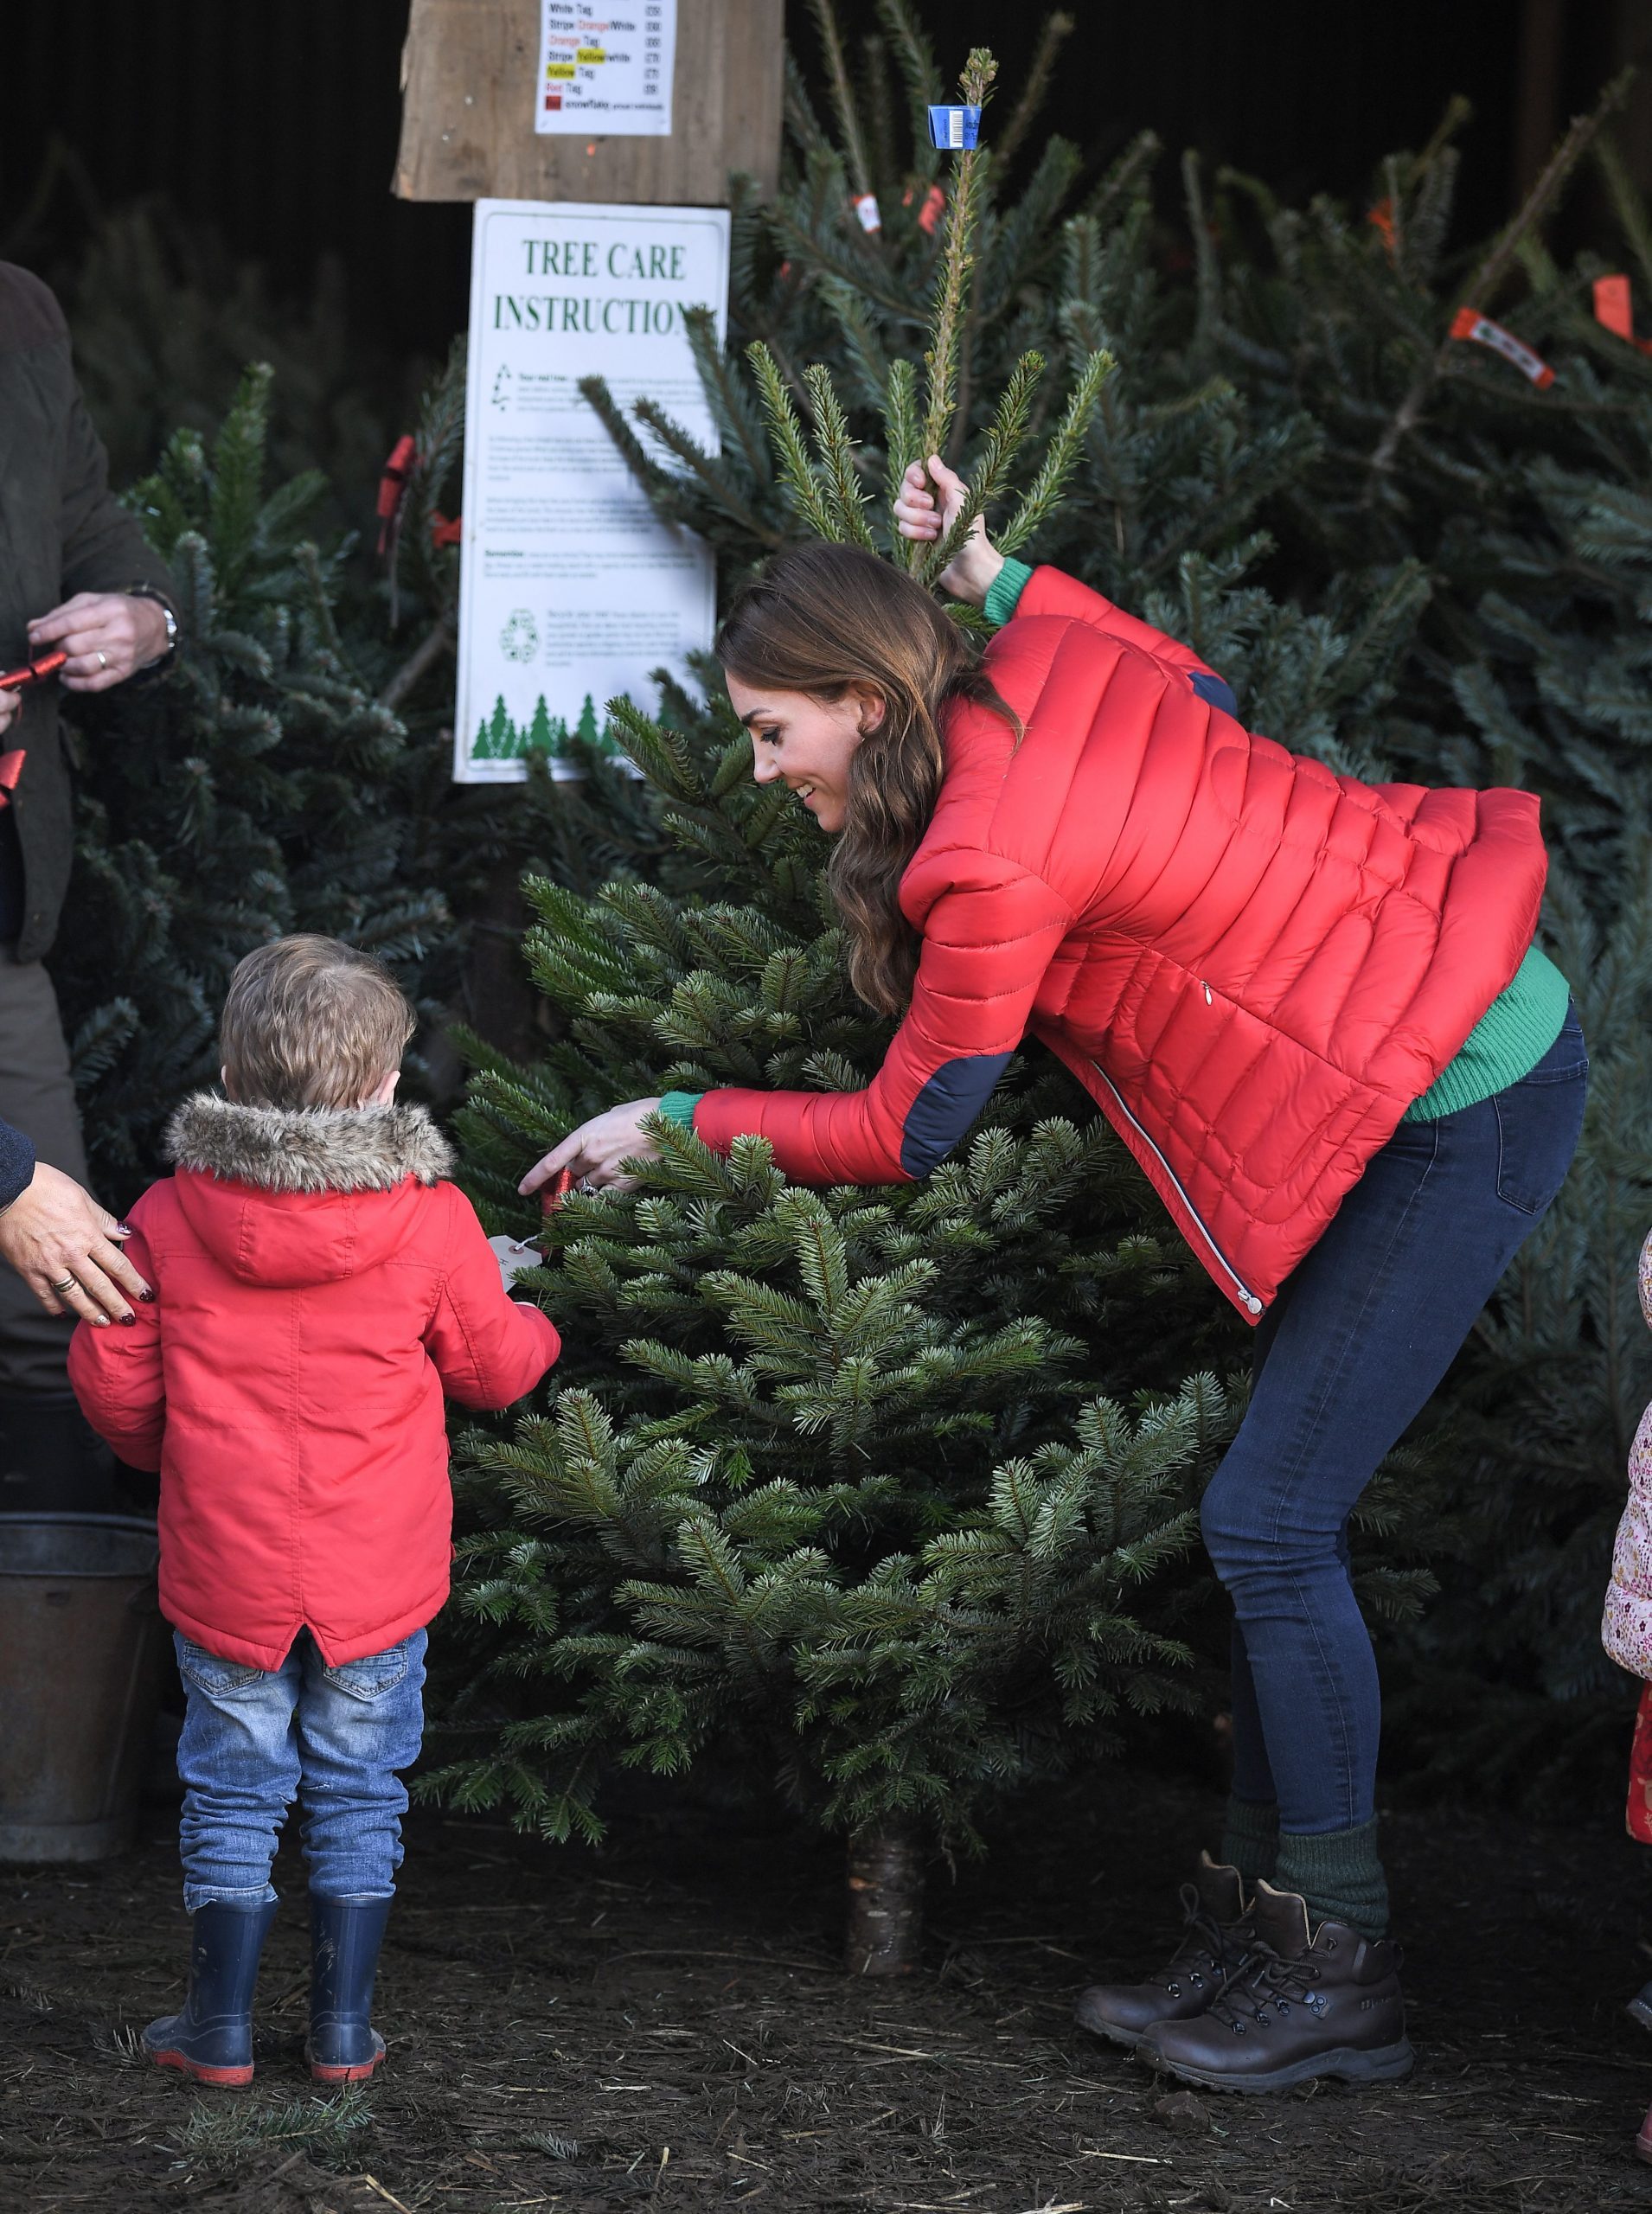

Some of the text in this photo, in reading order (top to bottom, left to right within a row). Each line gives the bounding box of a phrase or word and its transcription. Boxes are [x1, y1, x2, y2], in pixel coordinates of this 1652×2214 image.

[549, 3, 573, 14] White
[577, 3, 592, 16] Tag
[549, 20, 574, 30] Stripe
[548, 35, 580, 47] Orange
[584, 35, 599, 48] Tag
[548, 51, 573, 62] Stripe
[547, 66, 575, 77] Yellow
[579, 67, 594, 80] Tag
[567, 84, 581, 95] Tag
[523, 239, 686, 281] TREE CARE
[493, 294, 701, 336] INSTRUCTION
